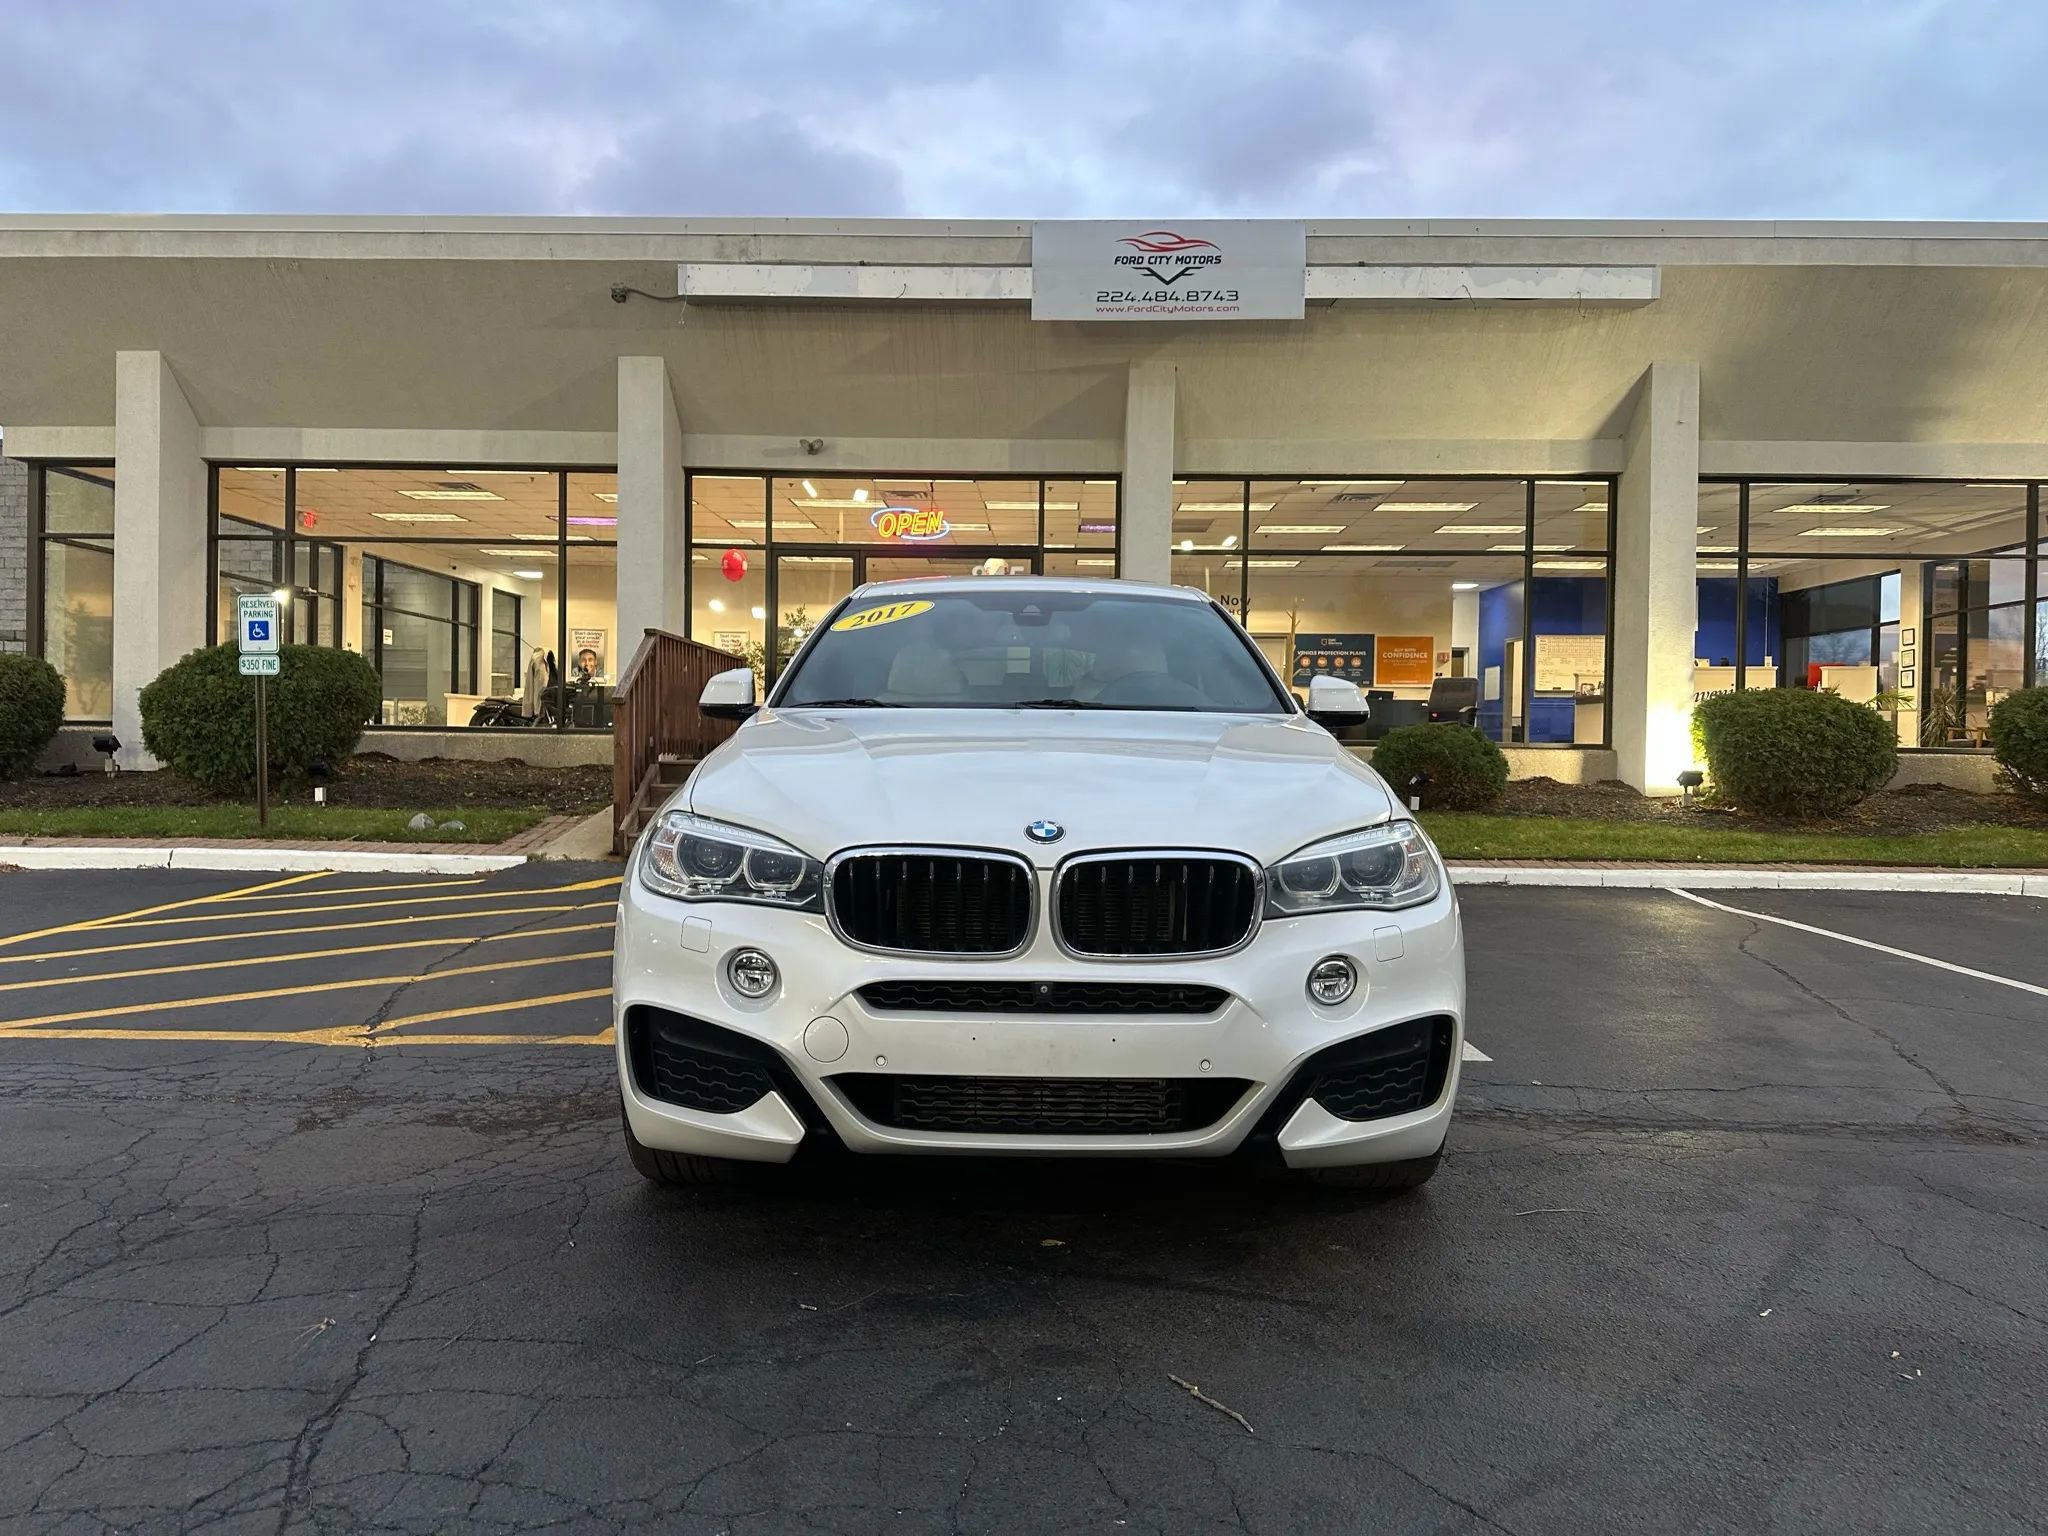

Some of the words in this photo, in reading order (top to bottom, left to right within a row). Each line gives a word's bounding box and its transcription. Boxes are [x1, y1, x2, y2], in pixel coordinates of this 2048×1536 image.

[1114, 255, 1144, 265] FORD
[1147, 255, 1173, 265] CITY
[1175, 255, 1222, 265] MOTORS
[1096, 290, 1239, 303] 224.484.8743
[1096, 304, 1240, 314] www.FordCityMotors.com
[878, 511, 944, 538] OPEN
[241, 600, 275, 609] RESERVED
[243, 610, 273, 618] PARKING
[850, 602, 917, 628] 2017
[241, 659, 260, 671] $350
[262, 659, 277, 670] FINE
